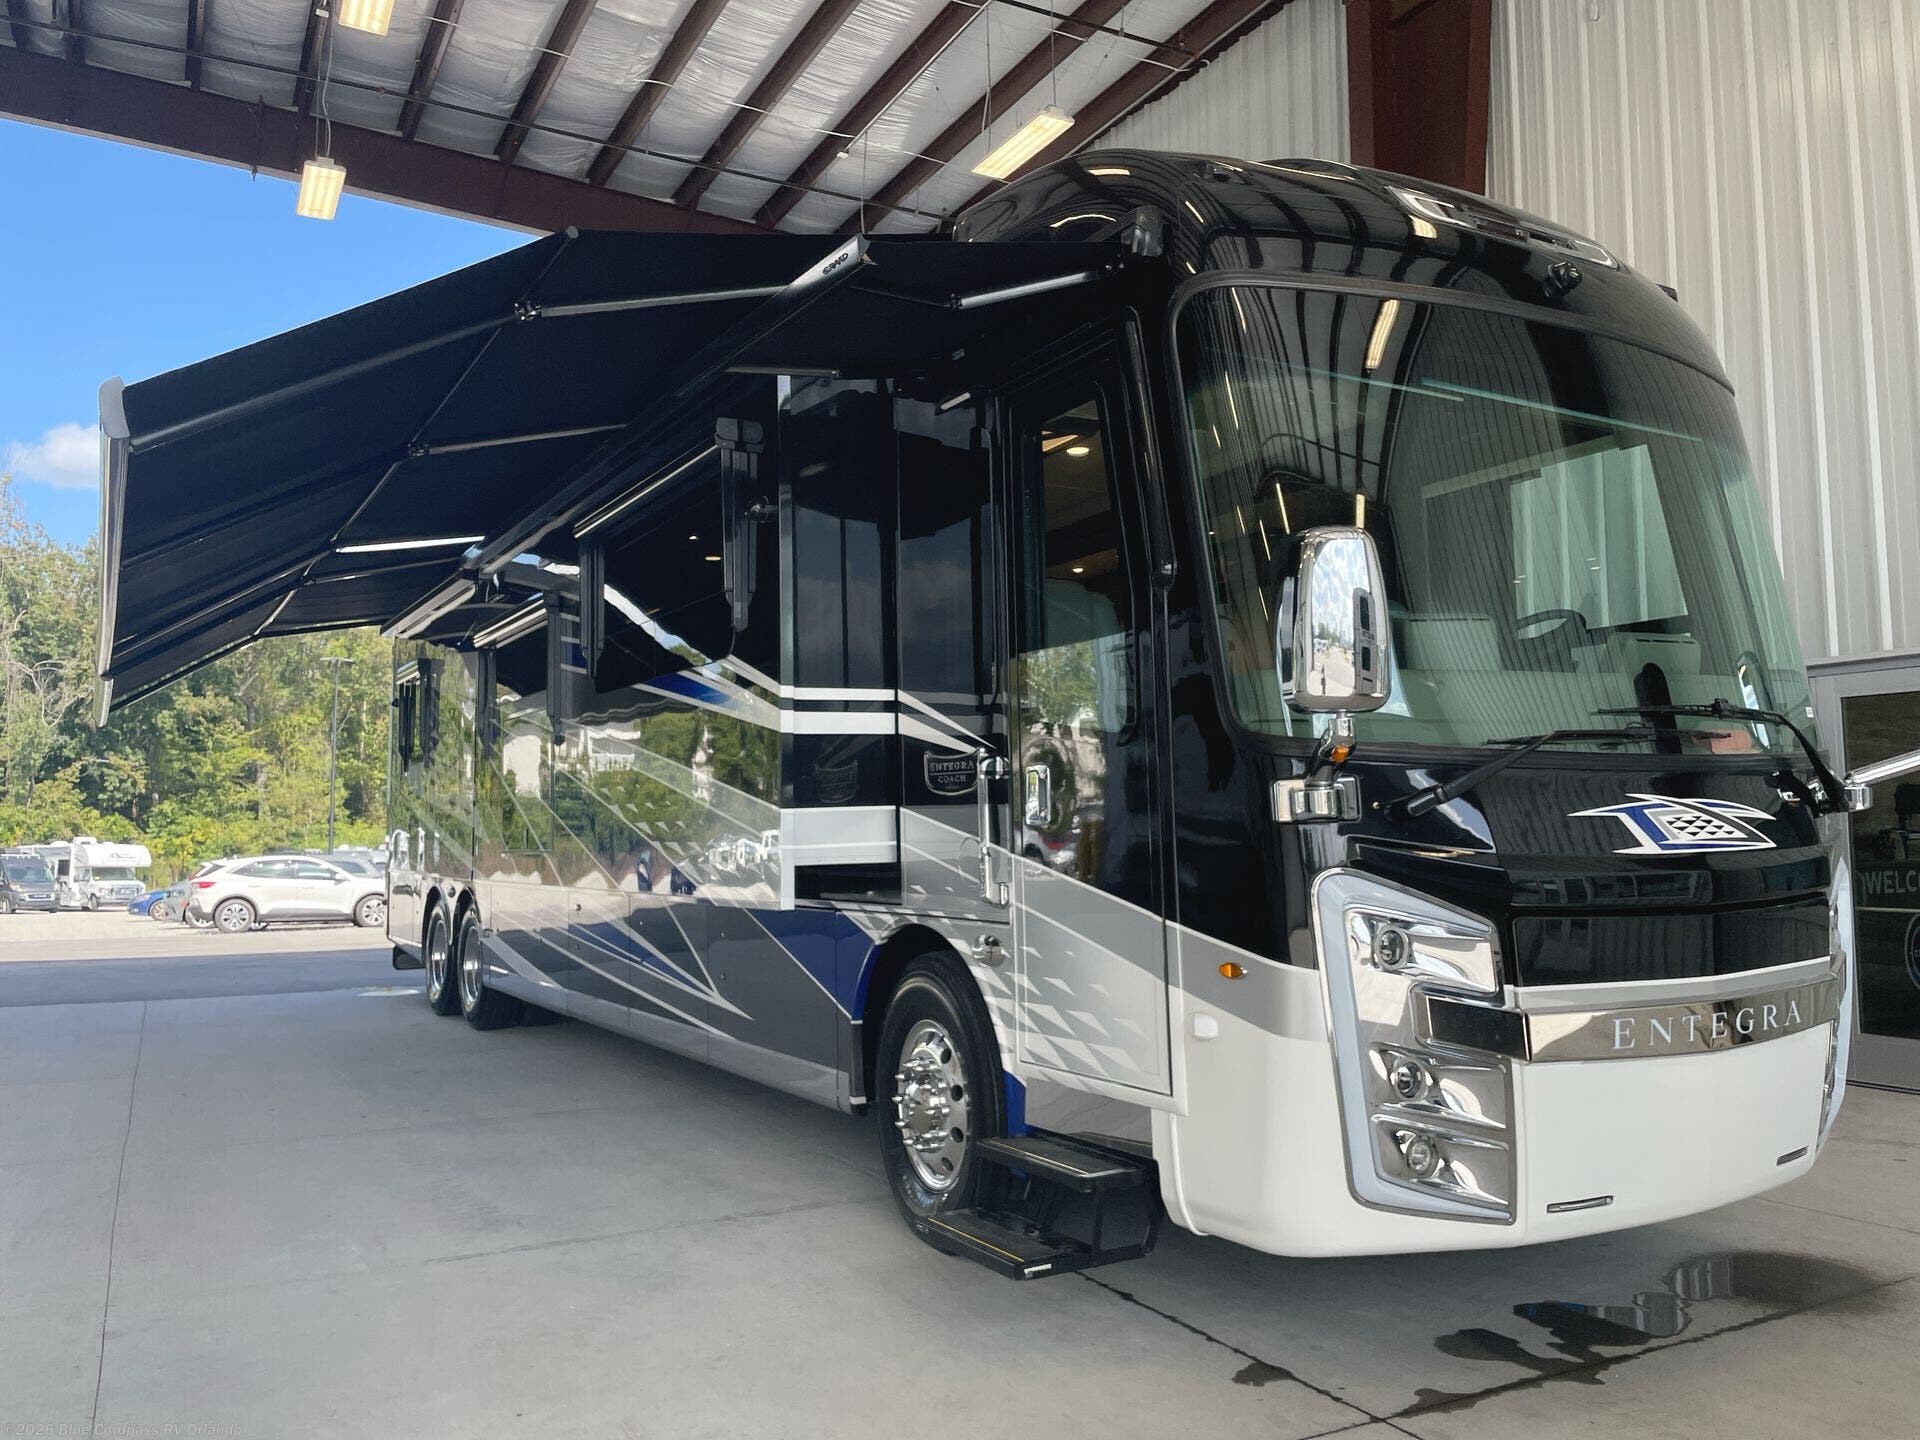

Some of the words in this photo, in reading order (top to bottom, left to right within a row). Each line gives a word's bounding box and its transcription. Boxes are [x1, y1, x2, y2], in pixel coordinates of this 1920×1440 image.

[930, 760, 974, 771] ENTEGRA
[938, 775, 966, 783] COACH
[1864, 870, 1920, 895] WELC
[1611, 1000, 1802, 1050] ENTEGRA
